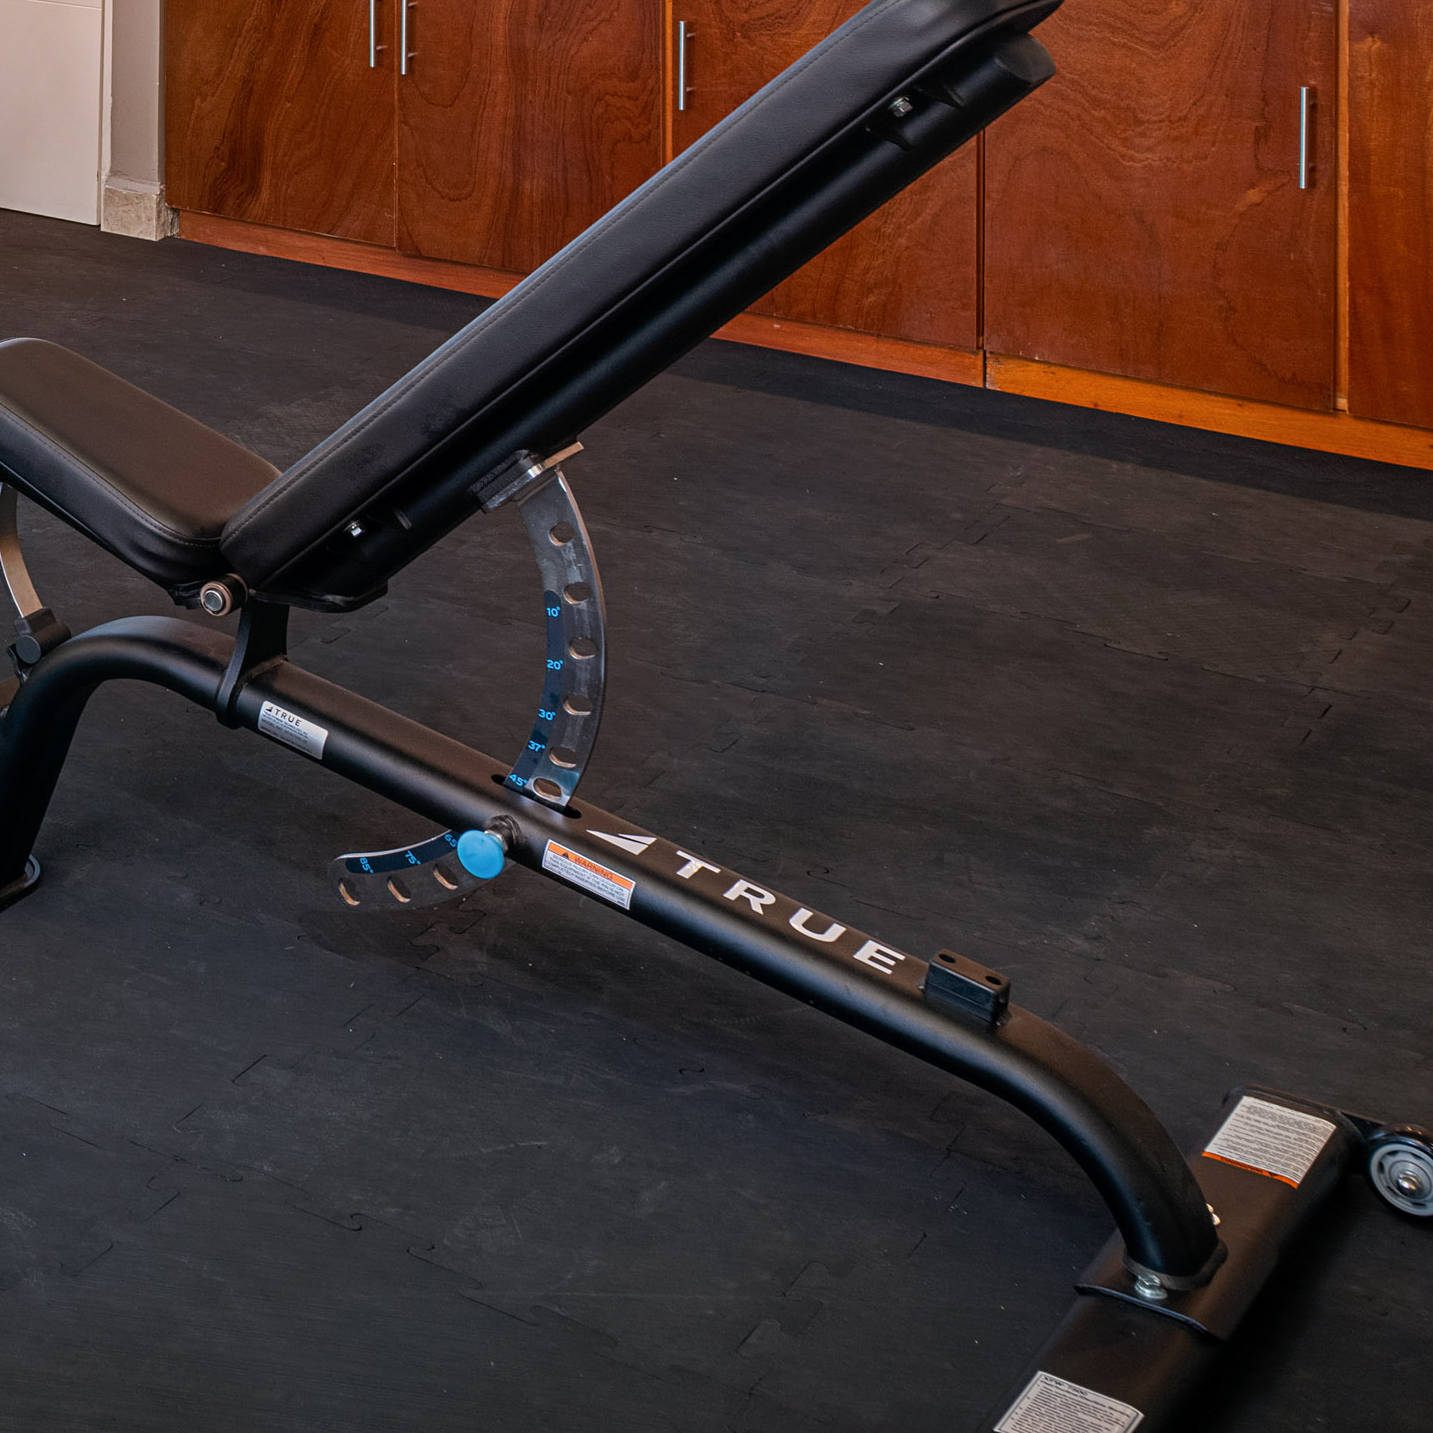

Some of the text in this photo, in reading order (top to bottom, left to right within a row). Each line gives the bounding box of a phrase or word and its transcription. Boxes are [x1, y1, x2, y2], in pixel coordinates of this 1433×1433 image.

[546, 659, 564, 671] 20°
[275, 706, 302, 727] TRUE
[538, 708, 556, 721] 30°
[574, 855, 614, 880] WARNING
[675, 849, 907, 975] TRUE
